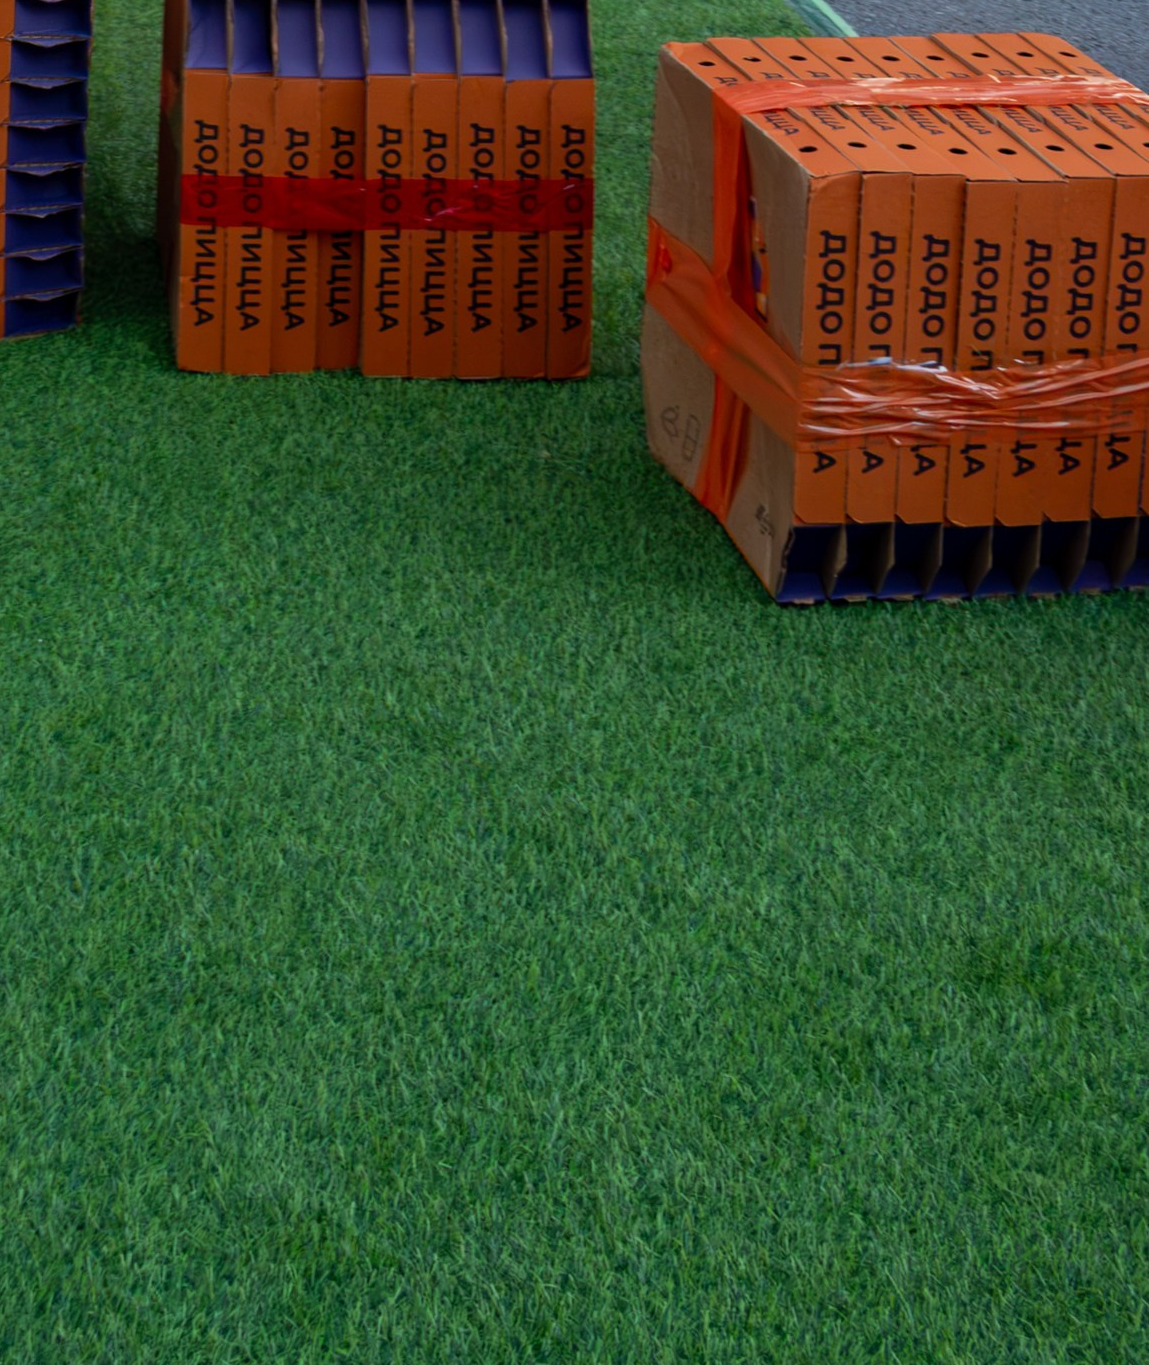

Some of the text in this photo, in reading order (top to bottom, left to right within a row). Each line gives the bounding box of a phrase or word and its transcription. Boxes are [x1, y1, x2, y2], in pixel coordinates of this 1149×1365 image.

[190, 120, 219, 326] ДОДО ПИЦЦА
[236, 124, 265, 331] ДОДО ПИЦЦА
[374, 124, 402, 332] ДОДО ПИЦЦА
[419, 225, 446, 336] ПИЦЦА
[467, 222, 493, 332] ПИЦЦА
[558, 222, 584, 332] ПИЦЦА
[816, 230, 847, 334] ДОДО
[866, 231, 897, 334] ДОДО
[918, 234, 949, 337] ДОДО
[970, 238, 1001, 341] ДОДО
[1020, 239, 1052, 341] ДОДО
[1066, 237, 1097, 338] ДОДО
[1115, 232, 1147, 335] ДОДО
